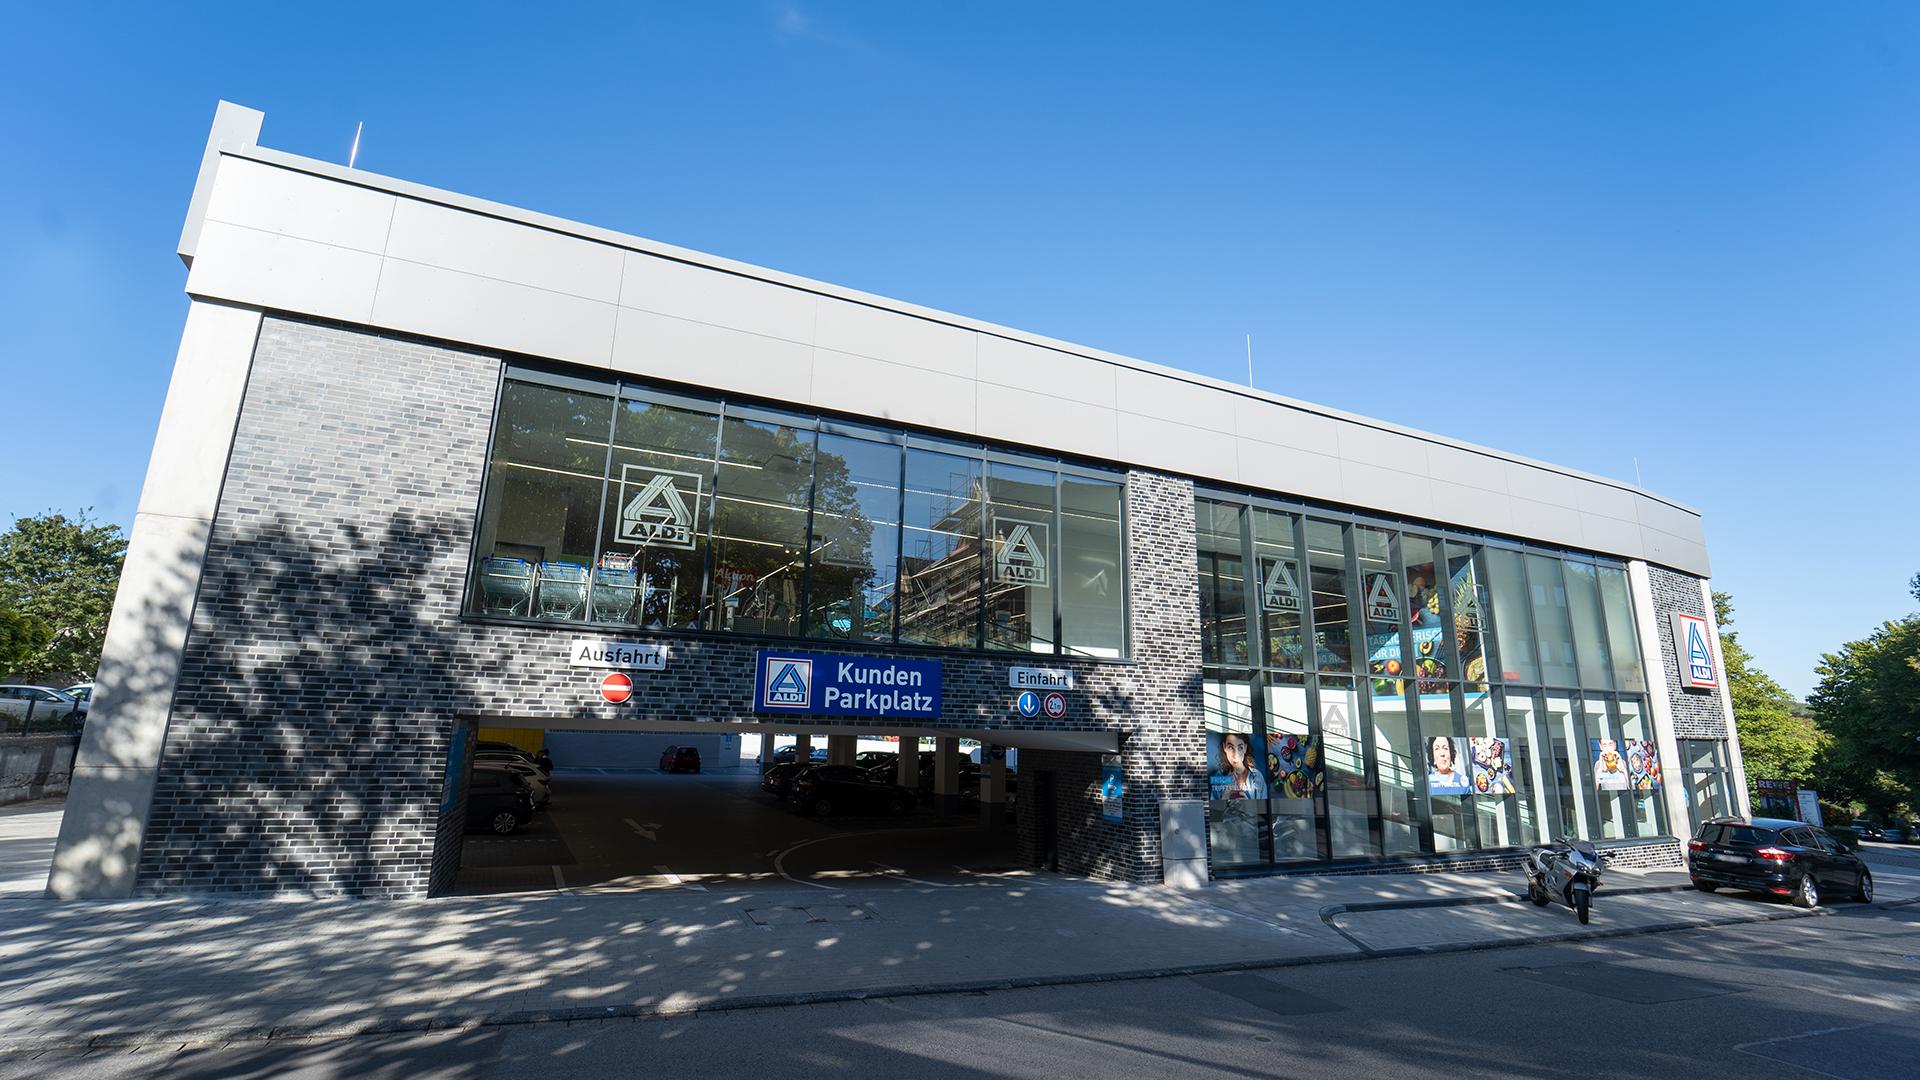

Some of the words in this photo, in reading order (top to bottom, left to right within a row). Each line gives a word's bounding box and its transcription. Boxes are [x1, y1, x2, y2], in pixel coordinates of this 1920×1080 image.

[629, 522, 684, 540] ALDI
[1002, 566, 1040, 580] ALDI
[1270, 596, 1297, 607] ALDI
[1373, 608, 1397, 618] ALDI
[579, 646, 660, 665] Ausfahrt
[838, 662, 922, 687] Kunden
[1017, 672, 1068, 686] Einfahrt
[1693, 666, 1712, 679] ALDI
[773, 692, 802, 702] ALDI
[824, 687, 933, 715] Parkplatz
